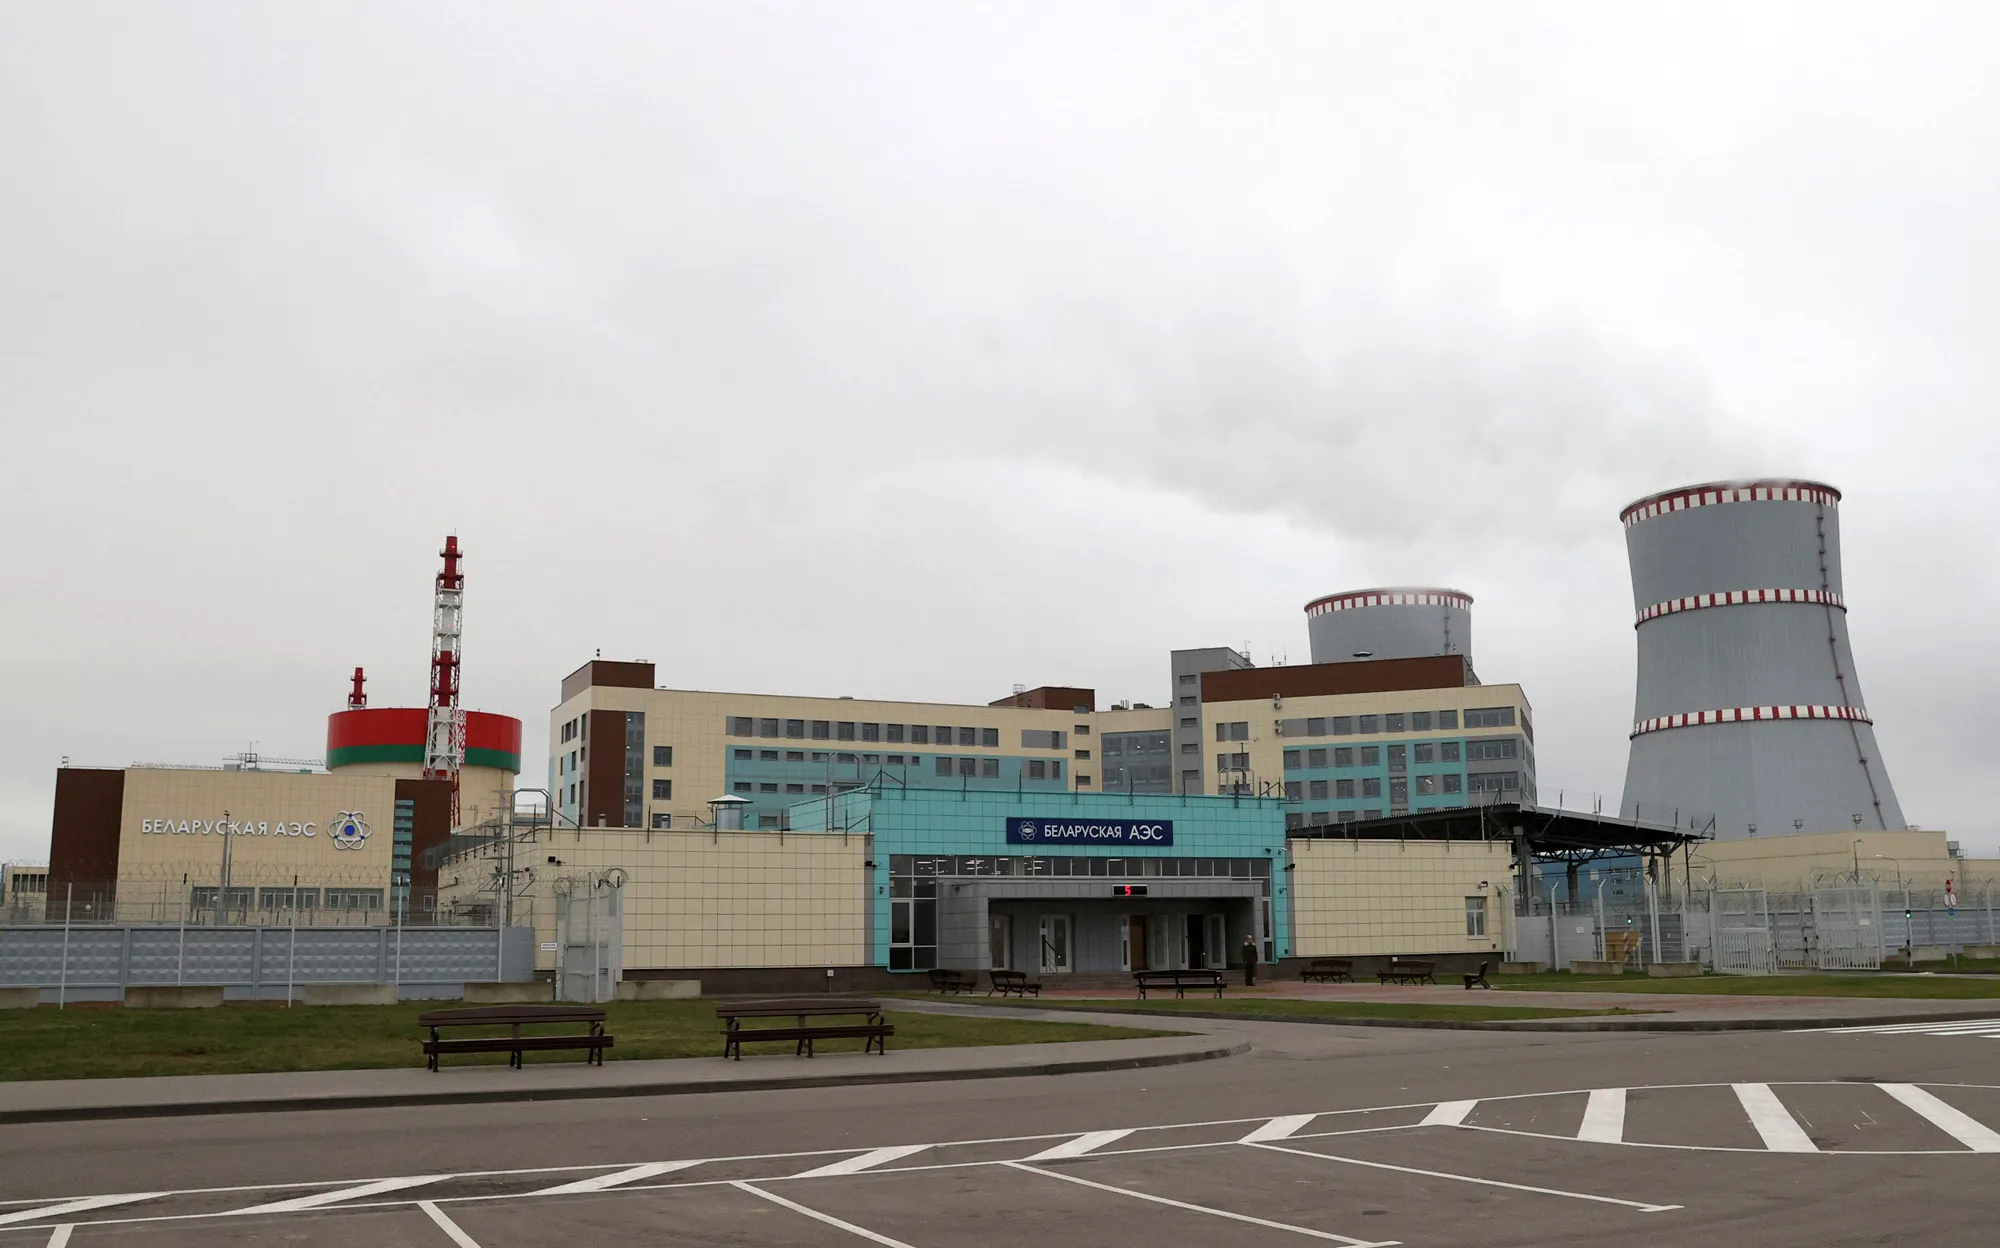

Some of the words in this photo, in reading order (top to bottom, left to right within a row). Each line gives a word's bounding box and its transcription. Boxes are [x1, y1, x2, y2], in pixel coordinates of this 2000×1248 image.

[141, 819, 268, 836] БЕЛАРУСКАЯ
[273, 822, 317, 837] АЭС
[1044, 825, 1122, 838] БЕЛАРУСКАЯ
[1129, 825, 1164, 840] АЭС
